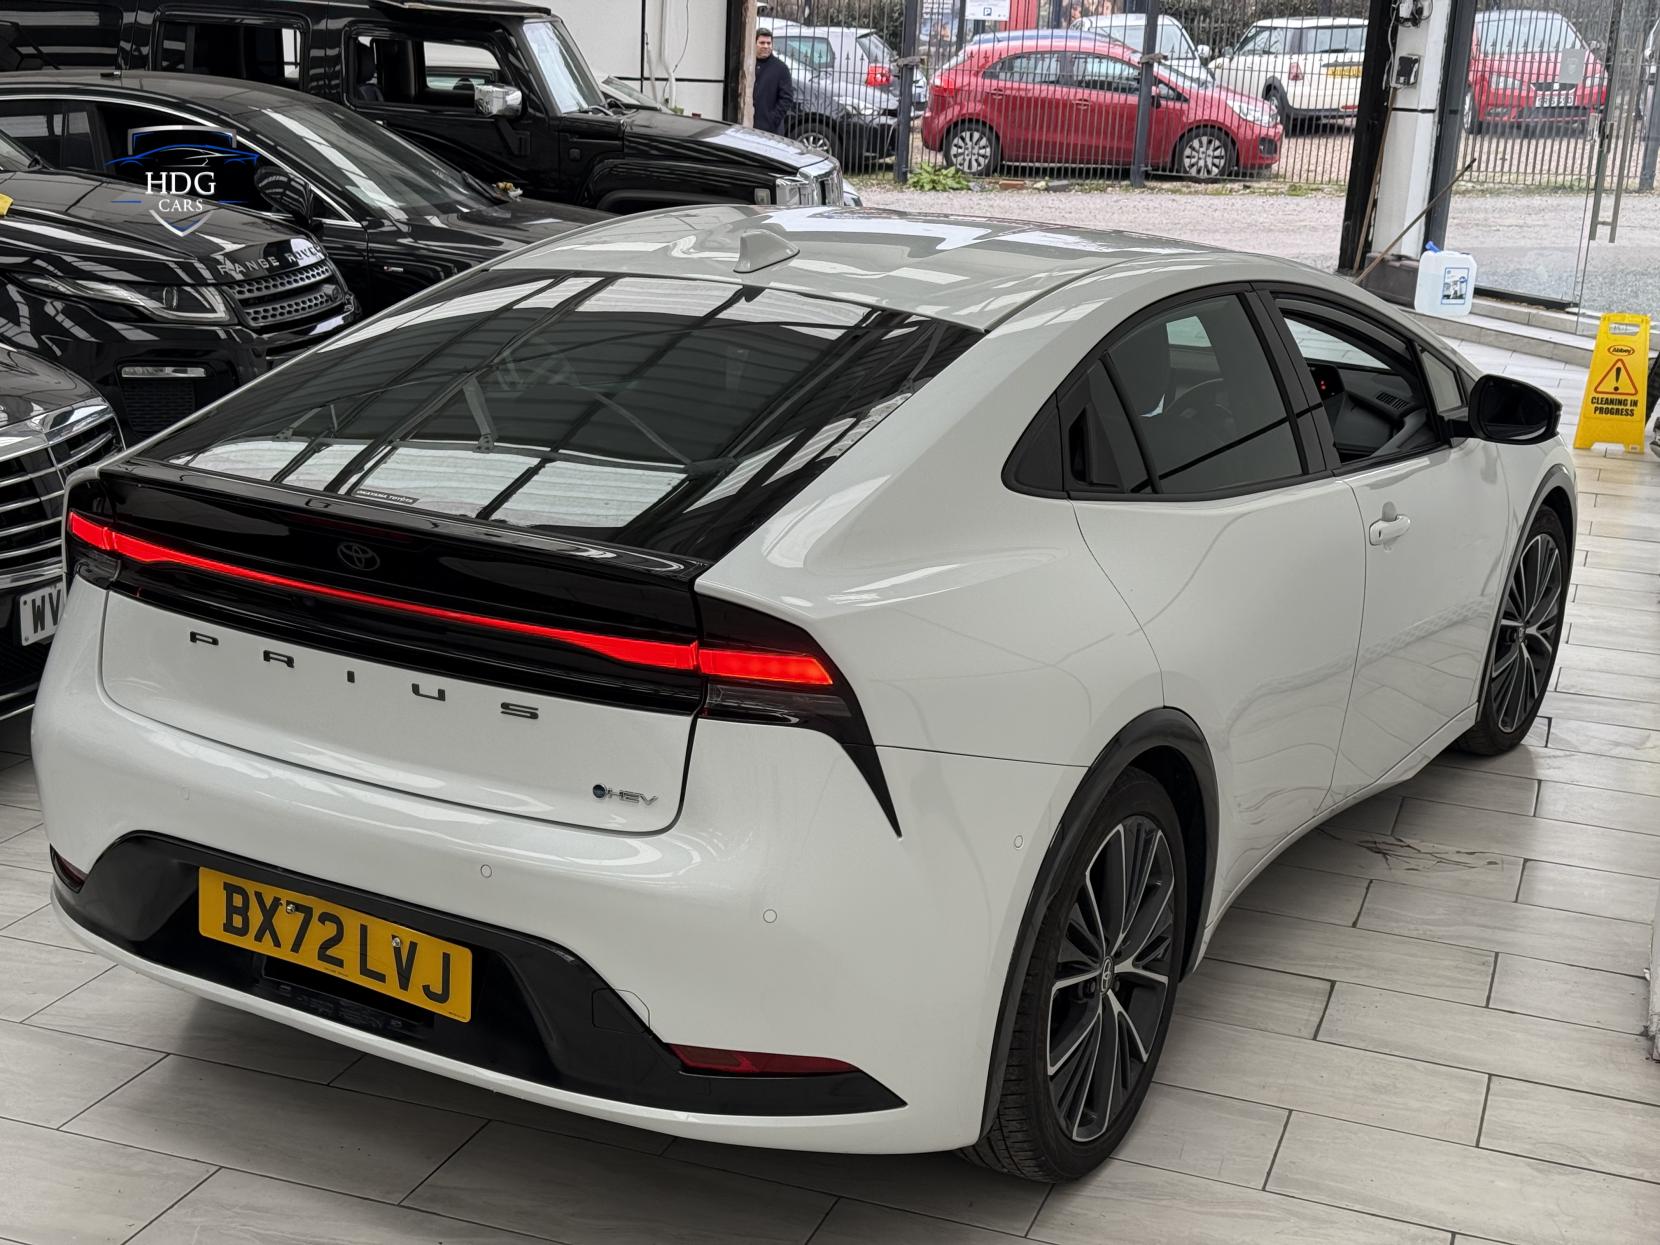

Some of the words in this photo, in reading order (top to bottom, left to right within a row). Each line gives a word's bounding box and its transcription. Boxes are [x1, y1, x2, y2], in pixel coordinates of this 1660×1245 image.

[217, 256, 280, 275] RANGE
[1591, 396, 1628, 407] CLEANING
[1629, 399, 1638, 407] IN
[1594, 406, 1634, 416] PROGRESS
[190, 631, 539, 719] PRIUS
[222, 881, 345, 970] BX72
[359, 923, 451, 1004] LVJ
